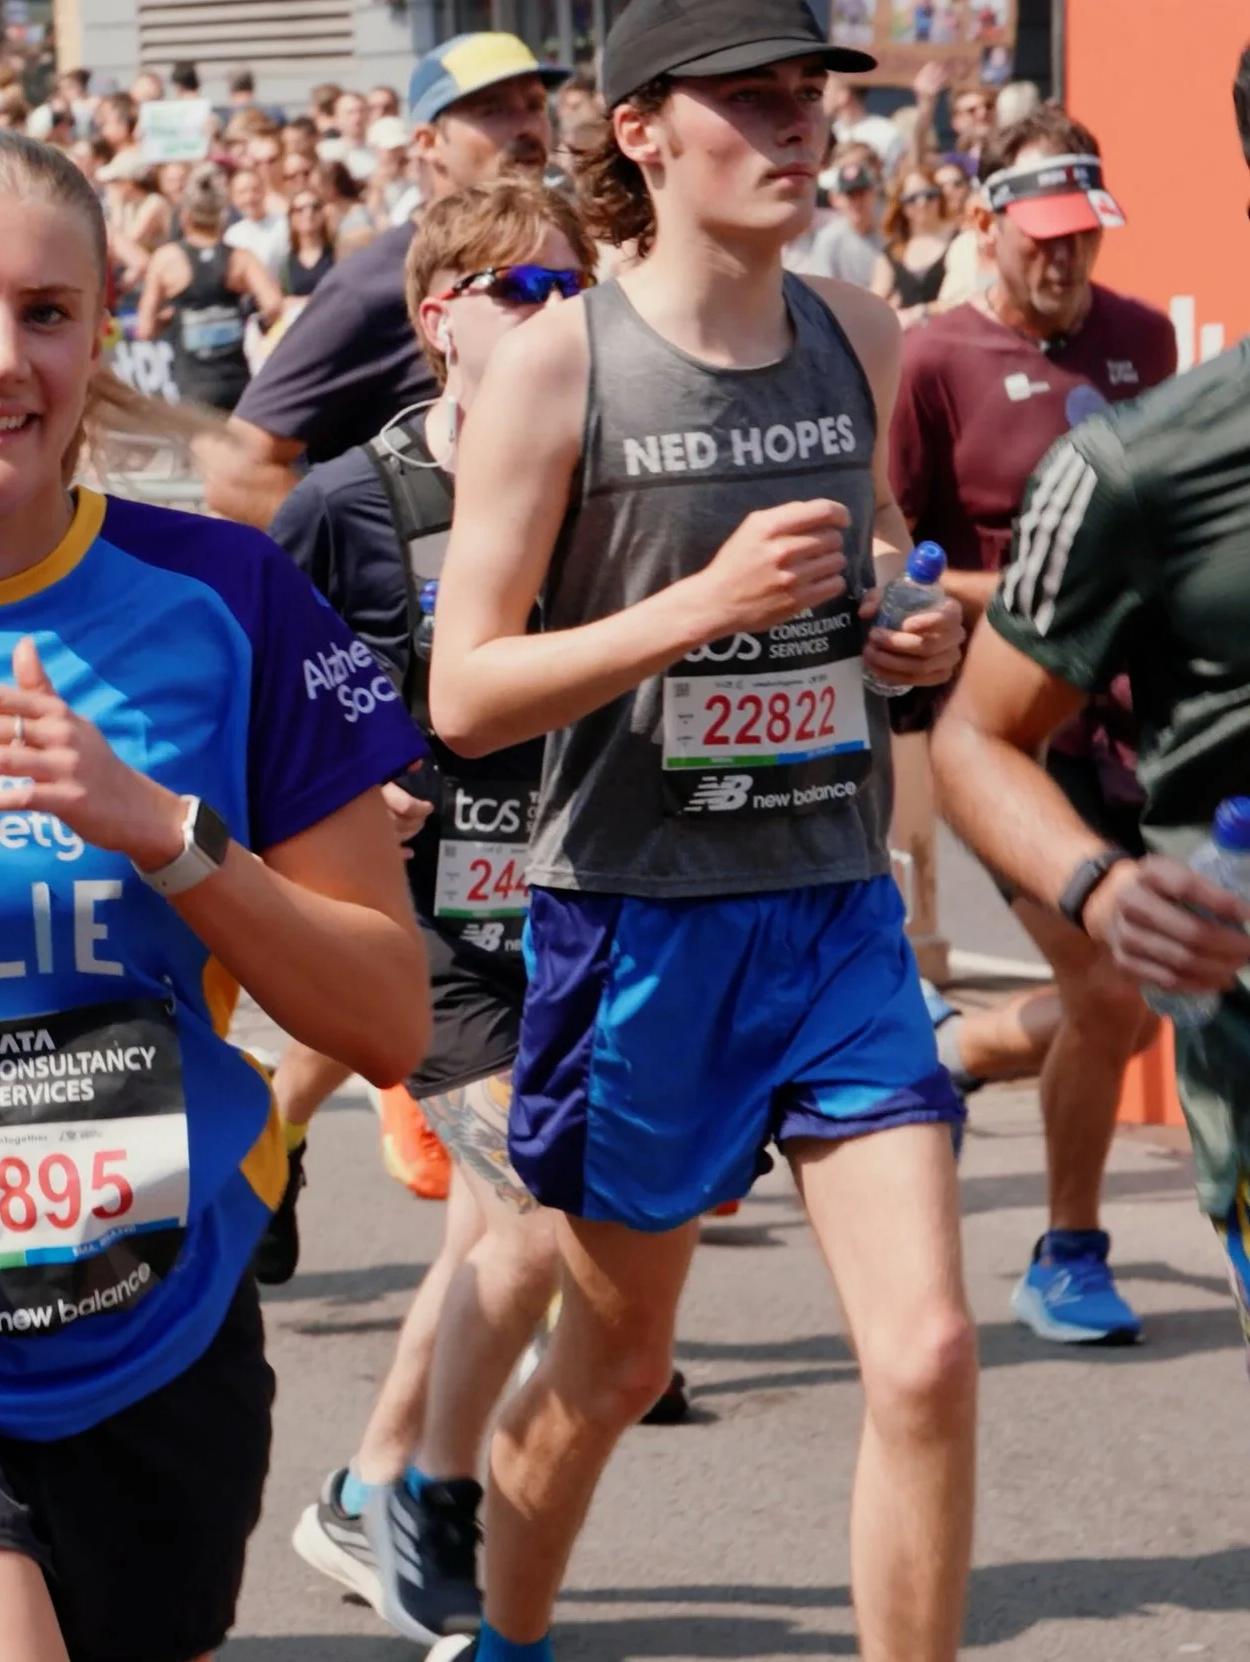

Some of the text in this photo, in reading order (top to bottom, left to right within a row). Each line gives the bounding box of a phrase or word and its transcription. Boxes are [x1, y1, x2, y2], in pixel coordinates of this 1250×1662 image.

[623, 414, 856, 476] NED HOPES
[769, 637, 830, 659] SERVICES
[703, 686, 836, 746] 22822
[454, 787, 521, 834] tcs
[753, 792, 790, 810] new
[793, 780, 857, 805] balance
